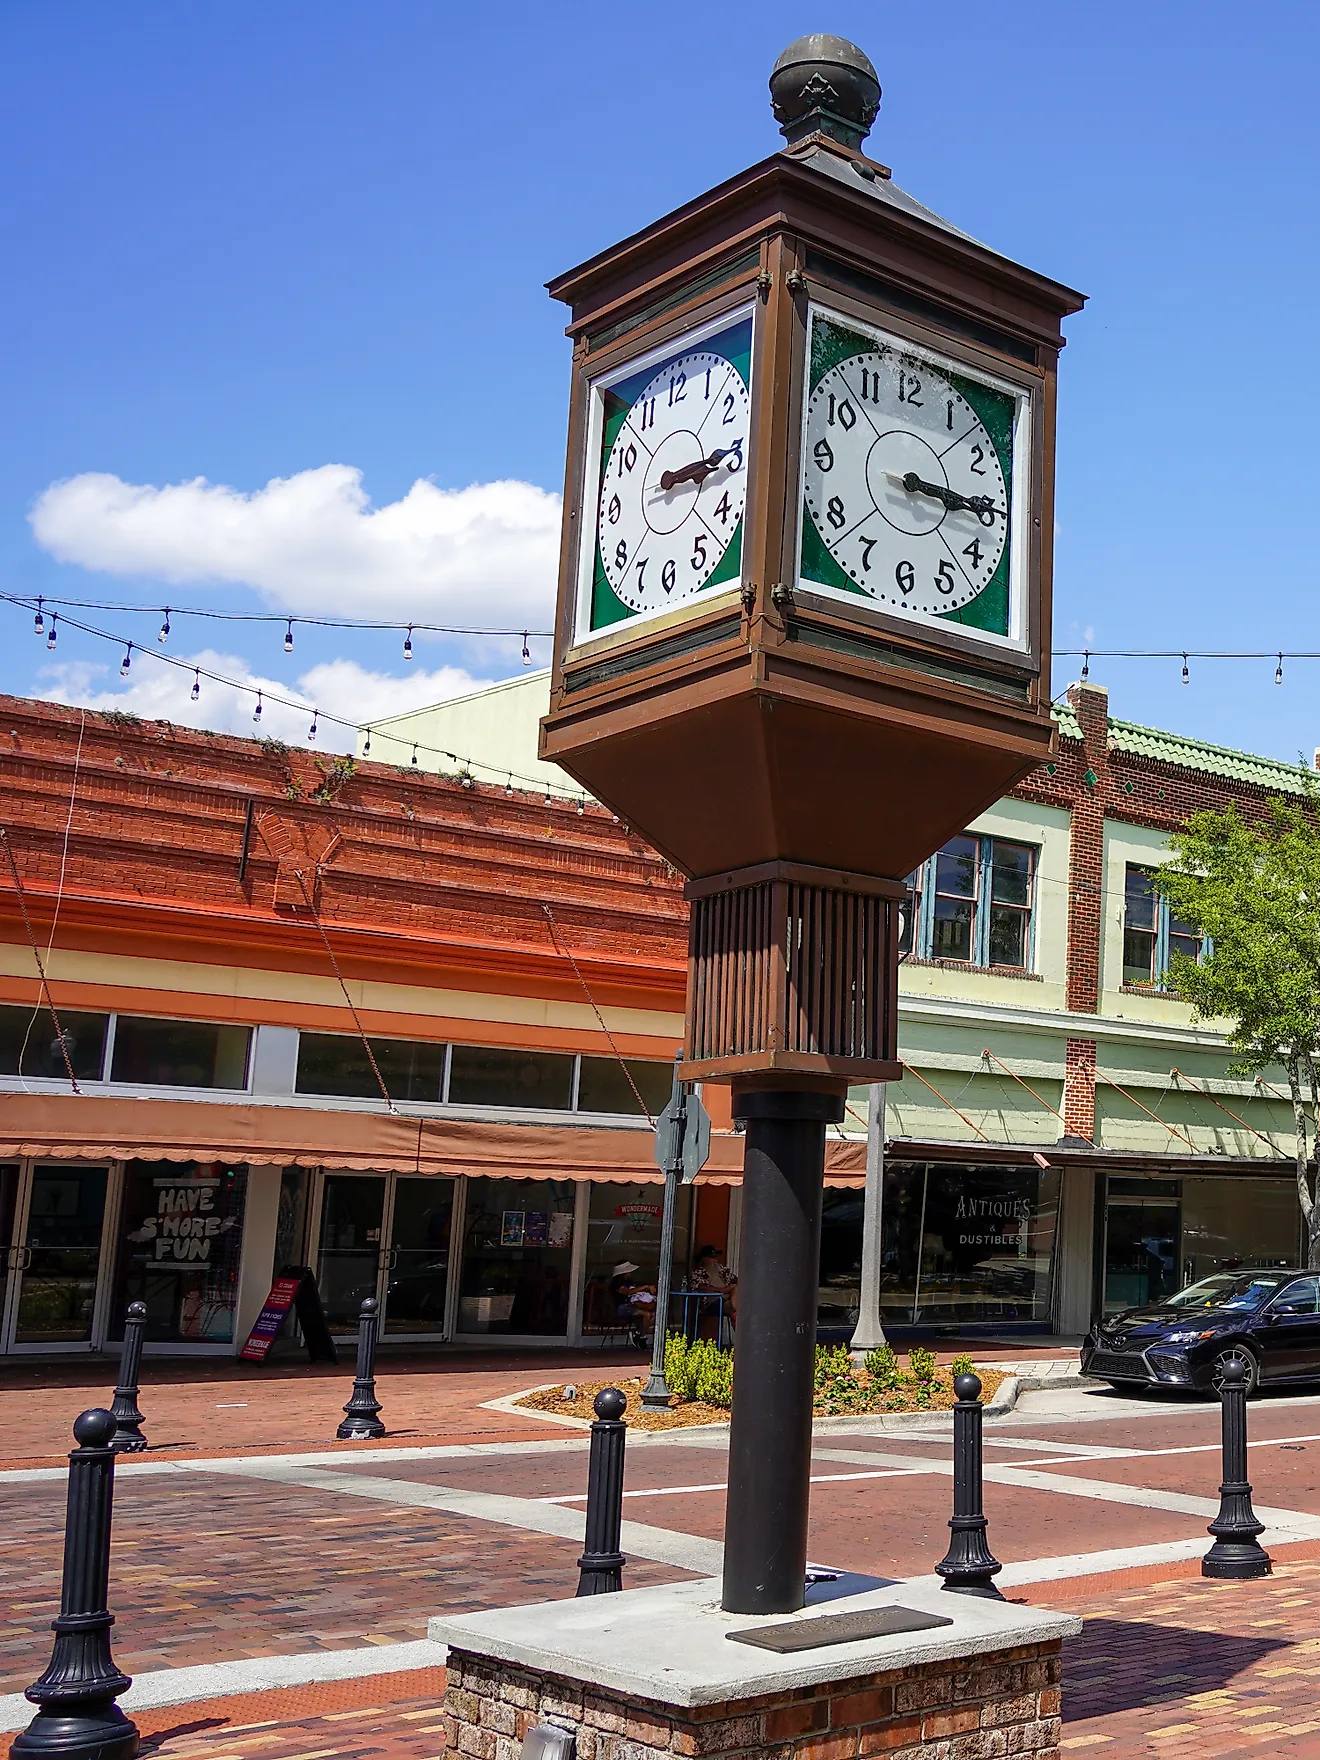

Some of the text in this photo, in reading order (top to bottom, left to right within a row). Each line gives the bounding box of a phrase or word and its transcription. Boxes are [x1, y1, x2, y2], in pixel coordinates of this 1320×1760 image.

[668, 370, 687, 408] 12
[704, 368, 711, 400] 1
[861, 368, 880, 404] 11
[898, 370, 924, 407] 12
[641, 396, 656, 431] 11
[723, 392, 736, 425] 2
[828, 393, 857, 431] 10
[946, 400, 954, 431] 1
[618, 442, 637, 478] 10
[814, 438, 834, 473] 9
[970, 444, 986, 476] 2
[608, 493, 621, 524] 9
[713, 490, 732, 525] 4
[827, 496, 846, 530] 8
[615, 539, 628, 571] 8
[690, 534, 708, 570] 5
[858, 535, 878, 572] 7
[962, 537, 985, 570] 4
[635, 557, 649, 594] 7
[662, 559, 676, 595] 6
[896, 560, 915, 596] 6
[934, 559, 956, 594] 5
[158, 1187, 214, 1214] HAVE
[621, 1205, 659, 1213] WONDERMADE
[955, 1195, 1031, 1220] ANTIQUES
[959, 1235, 1023, 1245] DUSTIBLES
[989, 1224, 996, 1232] &
[155, 1238, 211, 1260] FUN
